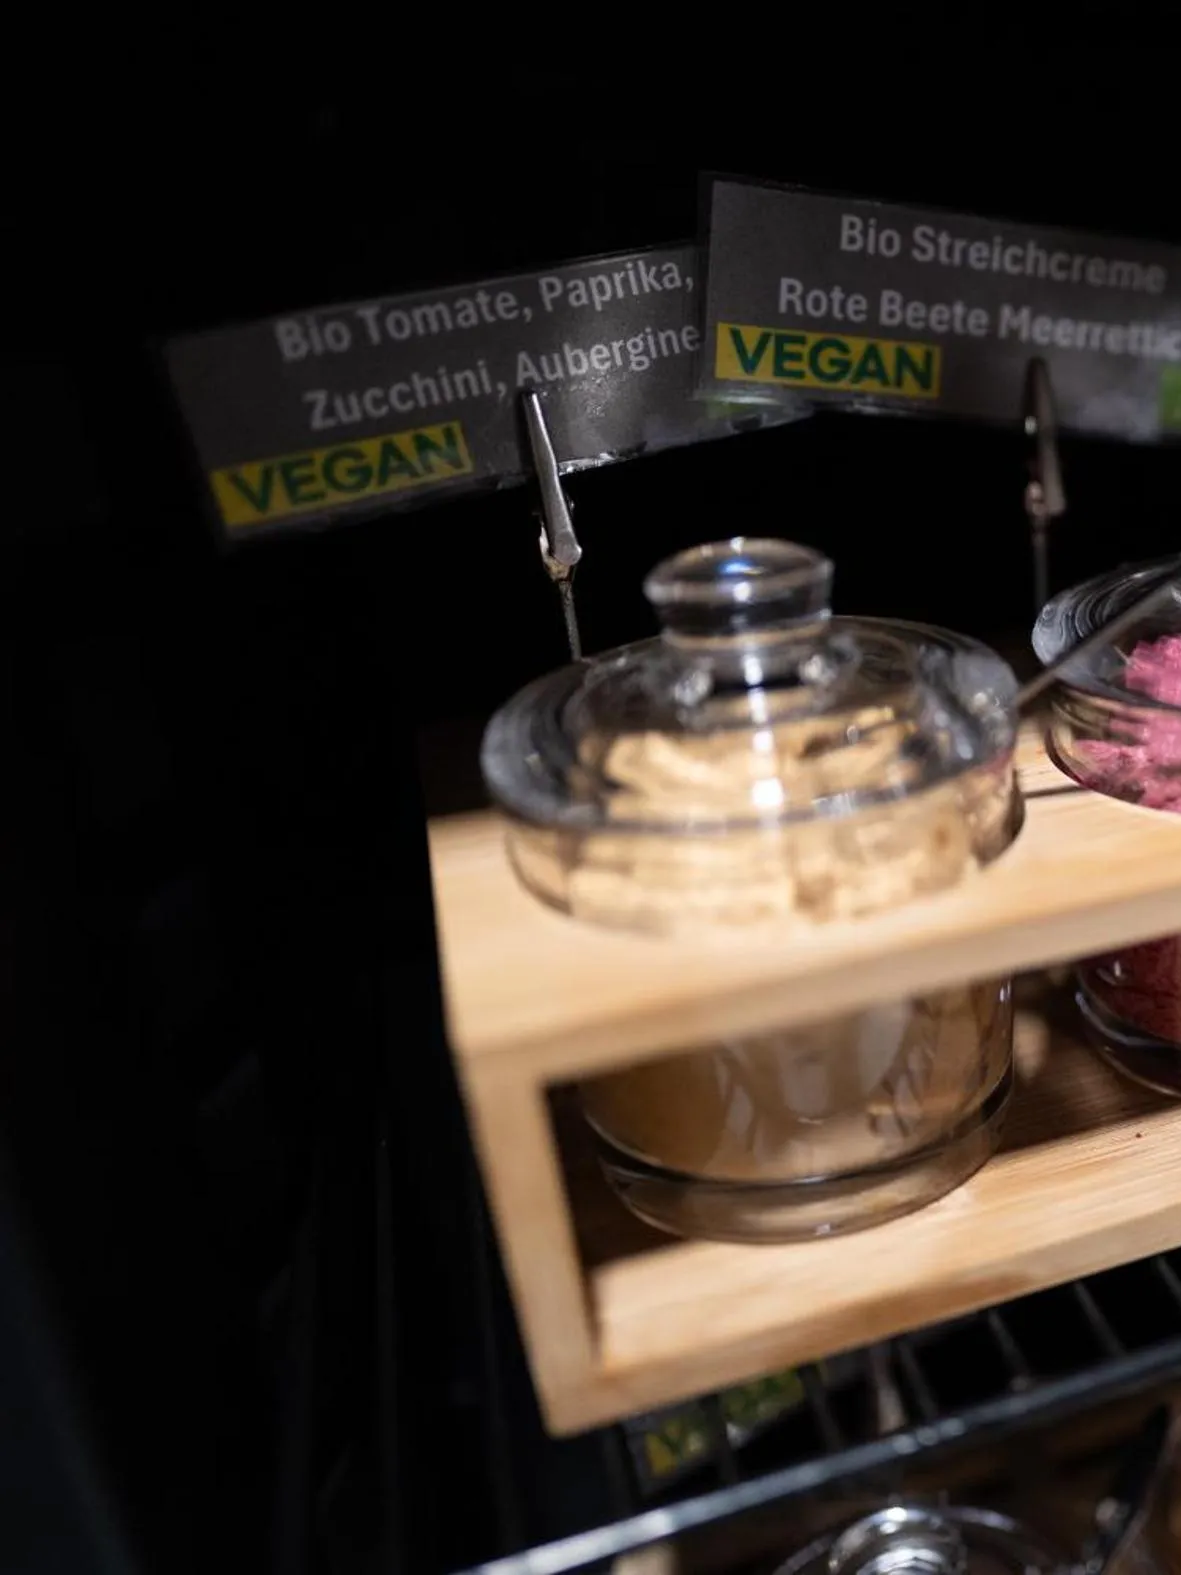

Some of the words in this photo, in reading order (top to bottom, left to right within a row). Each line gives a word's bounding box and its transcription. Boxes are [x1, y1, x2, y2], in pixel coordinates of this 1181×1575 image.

[839, 213, 902, 258] Bio
[911, 225, 1167, 296] Streichcreme
[274, 318, 353, 364] Bio
[358, 282, 533, 347] Tomate,
[538, 256, 696, 313] Paprika,
[777, 276, 869, 323] Rote
[878, 289, 988, 337] Beete
[301, 358, 508, 433] Zucchini,
[514, 319, 702, 389] Aubergine
[729, 327, 936, 391] VEGAN
[230, 425, 459, 515] VEGAN
